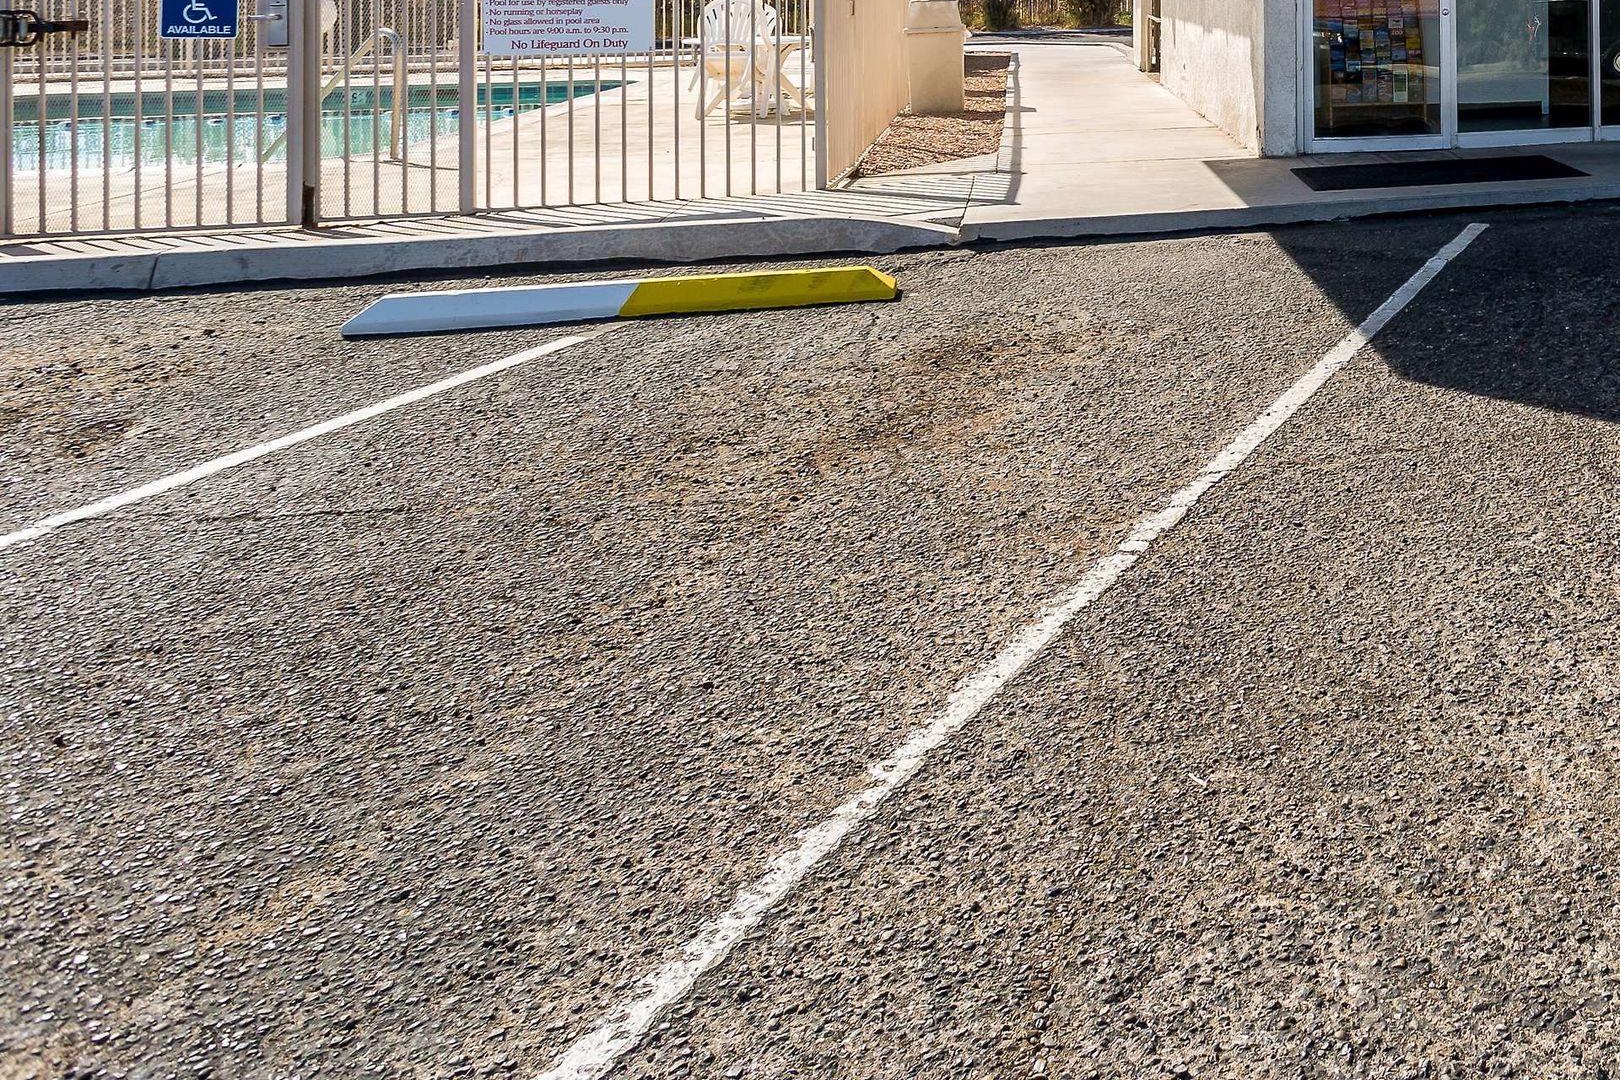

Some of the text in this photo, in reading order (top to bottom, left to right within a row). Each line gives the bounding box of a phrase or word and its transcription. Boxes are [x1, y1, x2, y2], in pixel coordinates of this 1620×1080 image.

[503, 9, 534, 17] running
[546, 8, 584, 17] horseplay
[489, 18, 502, 26] No
[503, 18, 522, 26] glass
[565, 18, 582, 26] pool
[167, 25, 231, 34] AVAILABLE
[611, 27, 629, 35] p.m.
[511, 38, 629, 50] No Lifeguard On Duty
